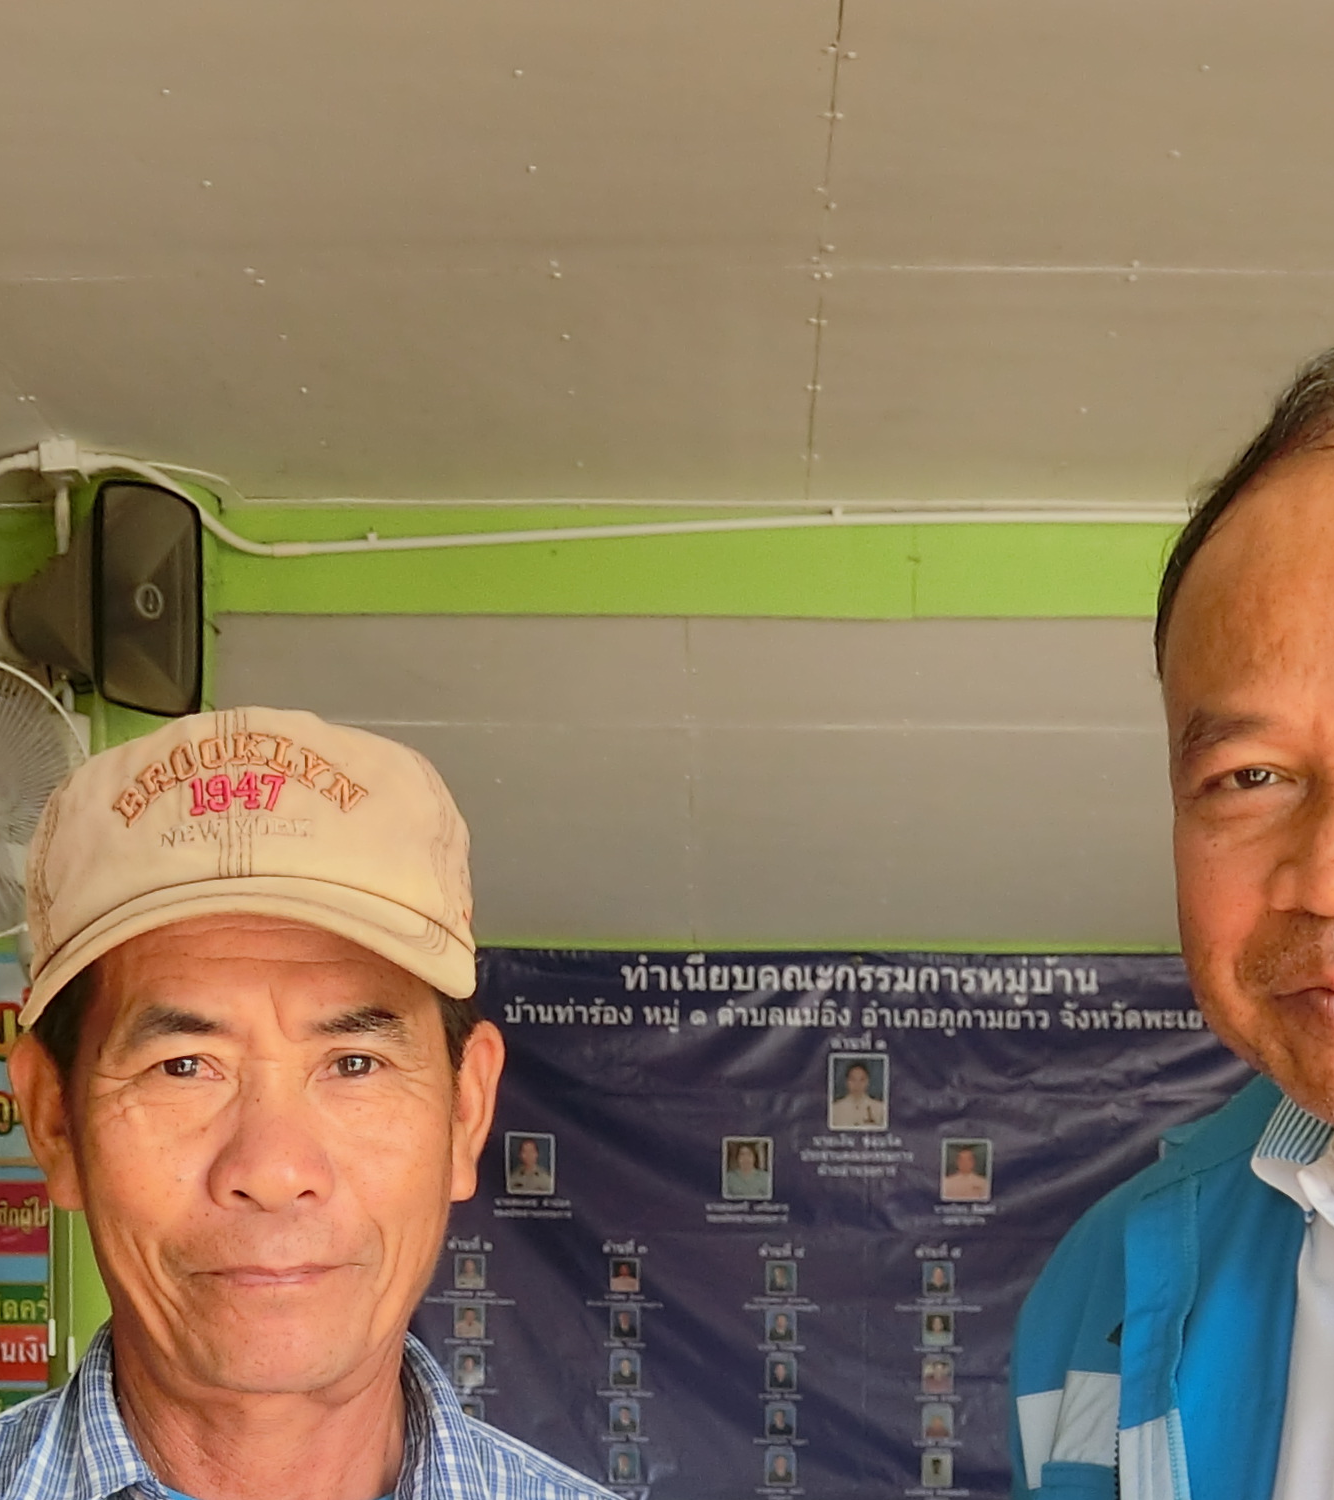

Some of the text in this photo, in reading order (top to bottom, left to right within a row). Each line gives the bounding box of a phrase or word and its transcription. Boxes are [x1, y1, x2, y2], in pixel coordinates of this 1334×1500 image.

[112, 731, 370, 828] BROOKLYN
[188, 770, 286, 816] 1947
[160, 822, 222, 848] NEW
[621, 956, 1100, 1006] ทำเนียบคณะกรรมการหมู่บ้าน
[504, 1000, 634, 1028] บ้านท่าร้อง
[643, 1000, 680, 1033] หมู่
[717, 1000, 851, 1028] ตำบลแม่อิง
[861, 1000, 1051, 1037] อำเภอภูกามยาว
[1059, 1001, 1208, 1031] จังหวัดพะเย
